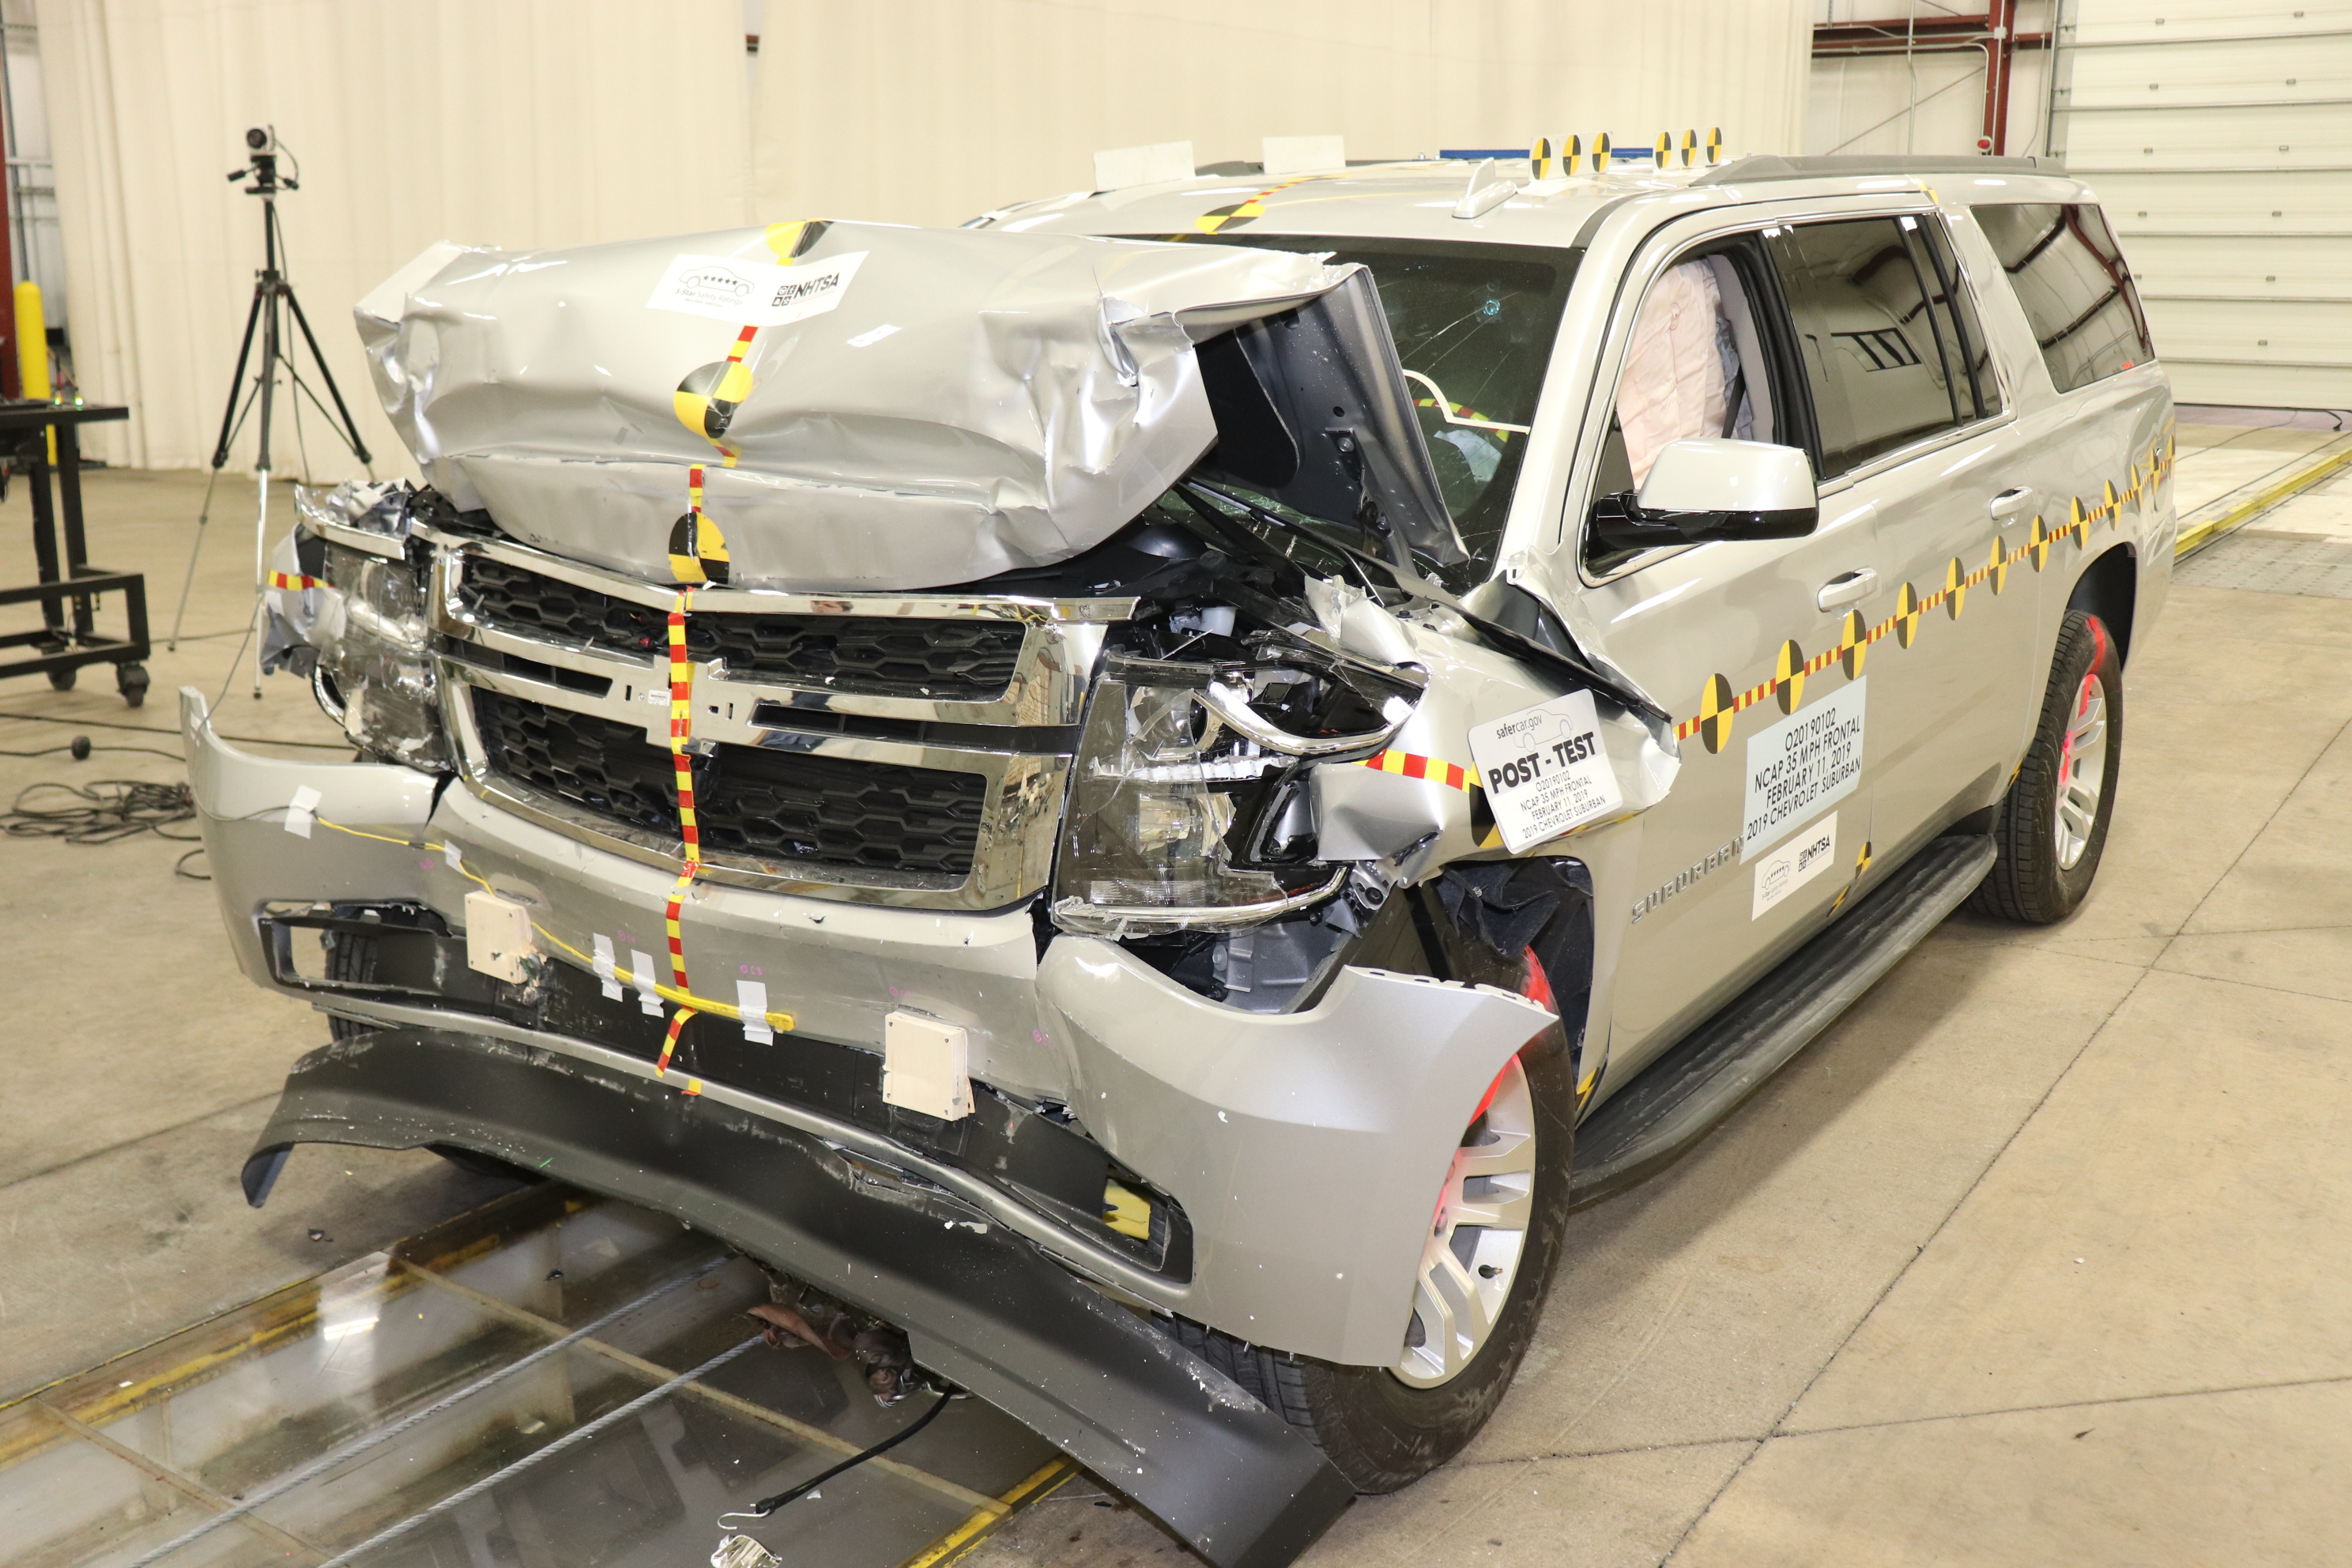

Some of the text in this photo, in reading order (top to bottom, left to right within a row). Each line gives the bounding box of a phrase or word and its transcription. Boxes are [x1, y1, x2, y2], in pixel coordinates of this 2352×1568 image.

[697, 292, 717, 301] Safety
[718, 295, 742, 306] Ratings
[793, 272, 839, 299] NHTSA
[1496, 714, 1543, 739] safercar.gov
[1785, 707, 1836, 752] O20190102
[1488, 752, 1541, 794] POST
[1551, 731, 1596, 767] TEST
[1755, 715, 1860, 793] NCAP 35 MPH FRONTAL
[1520, 775, 1592, 812] NCAP 35 MPH FRONTAL
[1766, 741, 1851, 808] FEBRUARY 11, 2019
[1522, 795, 1606, 839] 2019 CHEVROLET SUBURBAN
[1532, 800, 1562, 821] FEBRUARY
[1574, 790, 1589, 803] 2019
[1746, 755, 1861, 841] 2019 CHEVROLET SUBURBAN
[1807, 835, 1830, 861] NHTSA
